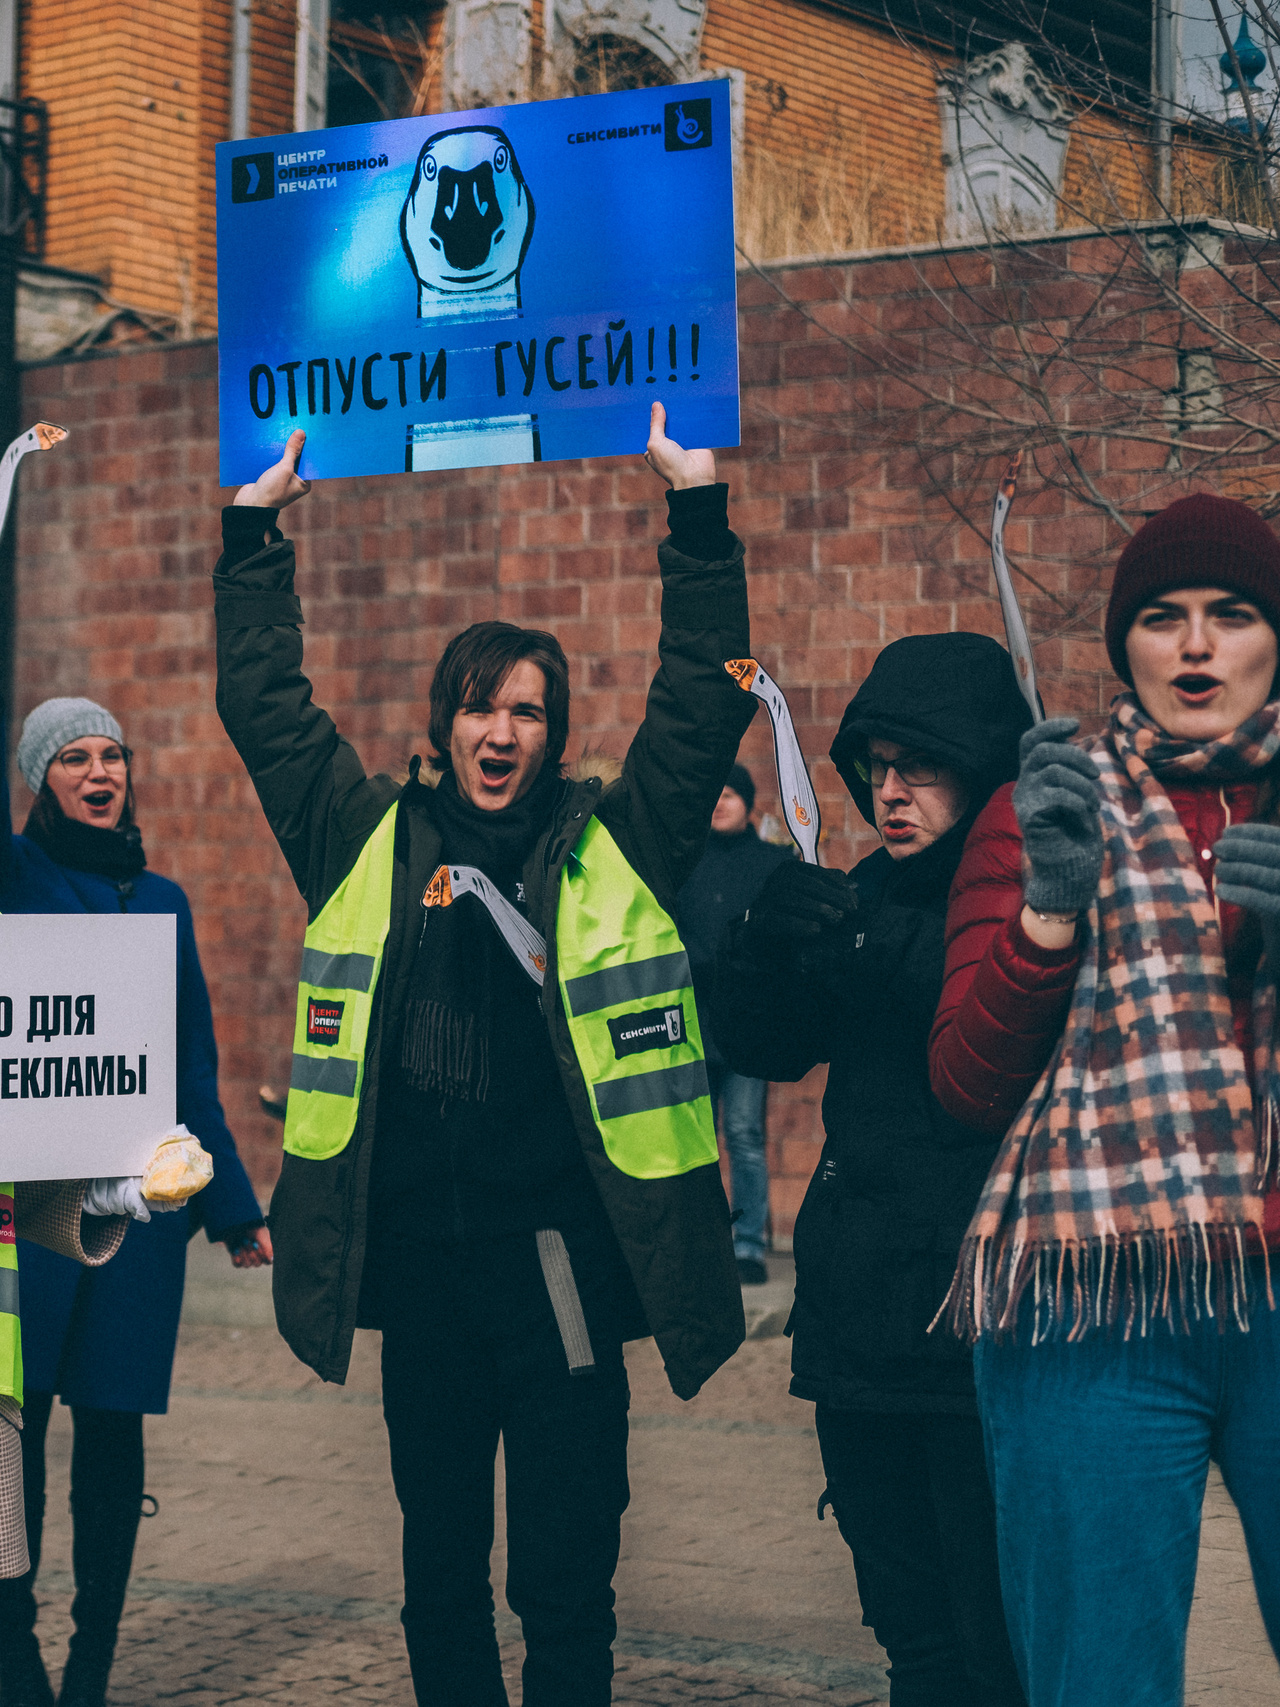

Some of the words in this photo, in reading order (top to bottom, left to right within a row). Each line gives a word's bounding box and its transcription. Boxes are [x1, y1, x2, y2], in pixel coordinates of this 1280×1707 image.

[567, 123, 662, 144] СЕНСИВИТИ
[277, 149, 326, 166] ЦЕНТР
[278, 153, 389, 180] ОПЕРАТИВНОЙ
[278, 177, 337, 194] ПЕЧАТИ
[248, 347, 447, 420] ОТПУСТИ
[494, 319, 700, 399] ГУСЕЙ!!!
[26, 994, 96, 1043] ДЛЯ
